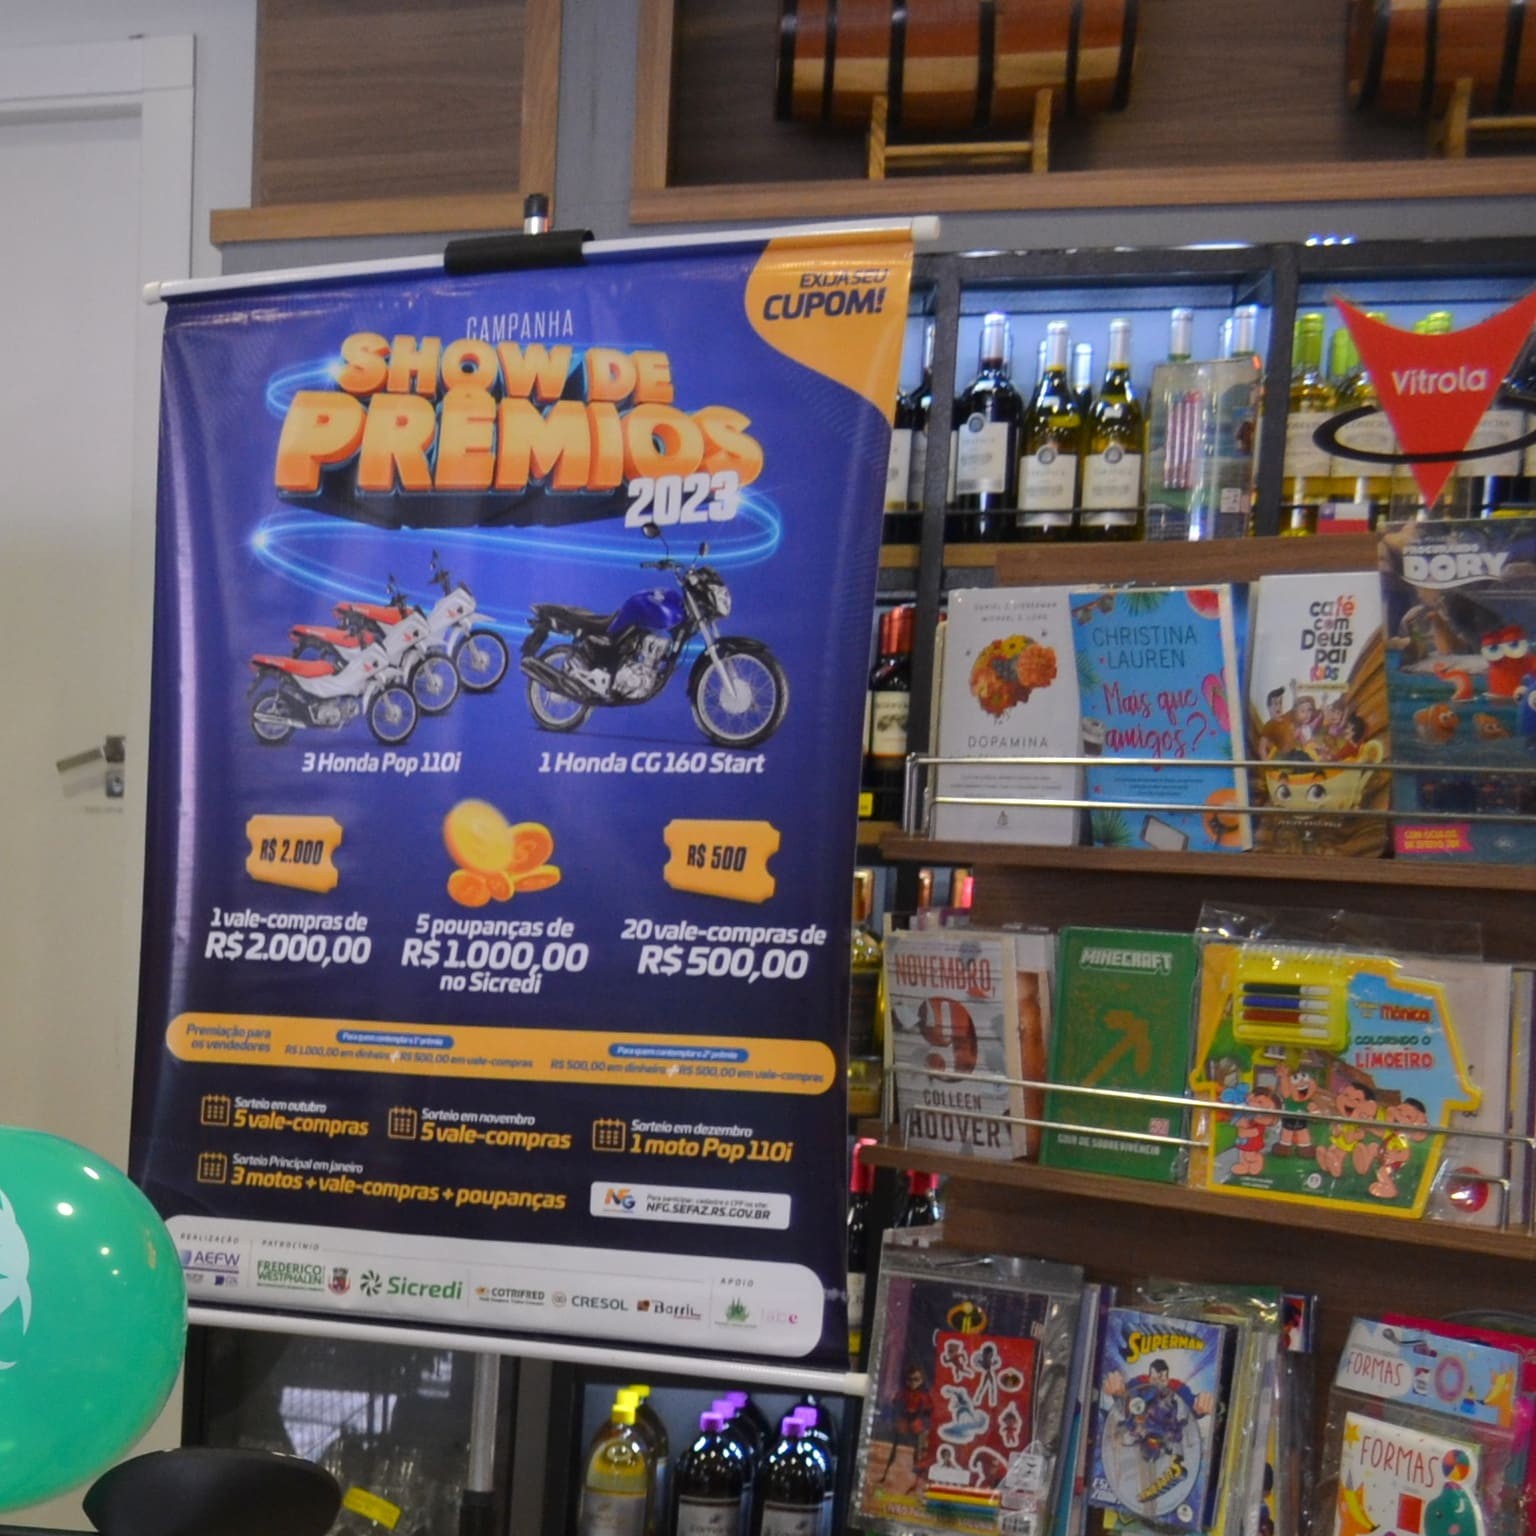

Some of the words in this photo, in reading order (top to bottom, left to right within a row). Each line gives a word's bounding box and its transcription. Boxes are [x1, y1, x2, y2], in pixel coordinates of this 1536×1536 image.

[800, 272, 848, 288] EXIJA
[763, 287, 887, 321] CUPOM!
[466, 309, 574, 342] CAMPANHA
[337, 332, 573, 401] SHOW
[585, 348, 675, 405] DE
[1391, 366, 1489, 397] Vitrola
[624, 471, 741, 529] 2023
[1402, 551, 1510, 582] DORY
[1309, 595, 1356, 618] café
[1092, 625, 1197, 647] CHRISTINA
[1313, 617, 1350, 631] com
[1301, 629, 1353, 650] Deus
[1108, 650, 1185, 670] LAUREN
[1314, 647, 1347, 666] pai
[1102, 681, 1152, 718] Mais
[1157, 687, 1198, 717] que
[968, 735, 1048, 749] DOPAMINA
[1105, 711, 1208, 772] amigos?
[301, 751, 315, 773] 3
[317, 751, 379, 773] Honda
[381, 751, 418, 777] Pop
[420, 751, 463, 773] 110i
[538, 751, 551, 773] 1
[554, 751, 628, 773] Honda
[630, 751, 662, 773] CG
[663, 751, 707, 774] 160
[708, 751, 766, 774] Start
[260, 837, 276, 862] R$
[280, 838, 324, 866] 2.000
[687, 843, 705, 869] R$
[711, 845, 747, 872] 500
[223, 908, 341, 935] vale-compras
[344, 911, 368, 931] de
[416, 913, 430, 934] 5
[431, 918, 544, 941] poupanças
[546, 917, 574, 938] de
[620, 918, 653, 942] 20
[654, 920, 798, 948] vale-compras
[800, 924, 827, 946] de
[1080, 947, 1173, 975] MINECRAFT
[440, 975, 466, 991] no
[468, 972, 543, 994] Sicredi
[918, 996, 978, 1083] 9
[234, 1097, 269, 1111] Sorteio
[288, 1100, 327, 1114] outubro
[924, 1088, 982, 1110] COLLEEN
[233, 1109, 246, 1128] 5
[248, 1110, 369, 1138] vale-compras
[421, 1108, 459, 1121] Sorteio
[461, 1112, 477, 1122] em
[479, 1113, 536, 1126] novembro
[631, 1119, 673, 1134] Sorteio
[674, 1124, 691, 1134] em
[692, 1123, 753, 1138] dezembro
[908, 1110, 1001, 1149] HOOVER
[421, 1121, 435, 1141] 5
[436, 1124, 572, 1151] vale-compras
[630, 1133, 643, 1154] 1
[644, 1137, 700, 1157] moto
[702, 1136, 743, 1164] Pop
[747, 1139, 794, 1163] 110i
[232, 1153, 268, 1167] Sorteio
[269, 1155, 312, 1173] Principal
[328, 1160, 364, 1175] janeiro
[231, 1166, 244, 1185] 3
[245, 1169, 302, 1190] motos
[318, 1175, 439, 1203] vale-compras
[455, 1186, 567, 1212] poupanças
[604, 1187, 636, 1209] NFG
[193, 1250, 241, 1267] AEFW
[257, 1260, 323, 1276] FREDERICO
[387, 1275, 463, 1300] Sicredi
[491, 1286, 545, 1302] COTRIFRED
[571, 1294, 629, 1312] CRESOL
[1126, 1330, 1205, 1364] SUPERMAN
[1347, 1352, 1403, 1387] FORMAS
[1360, 1435, 1439, 1488] FORMAS
